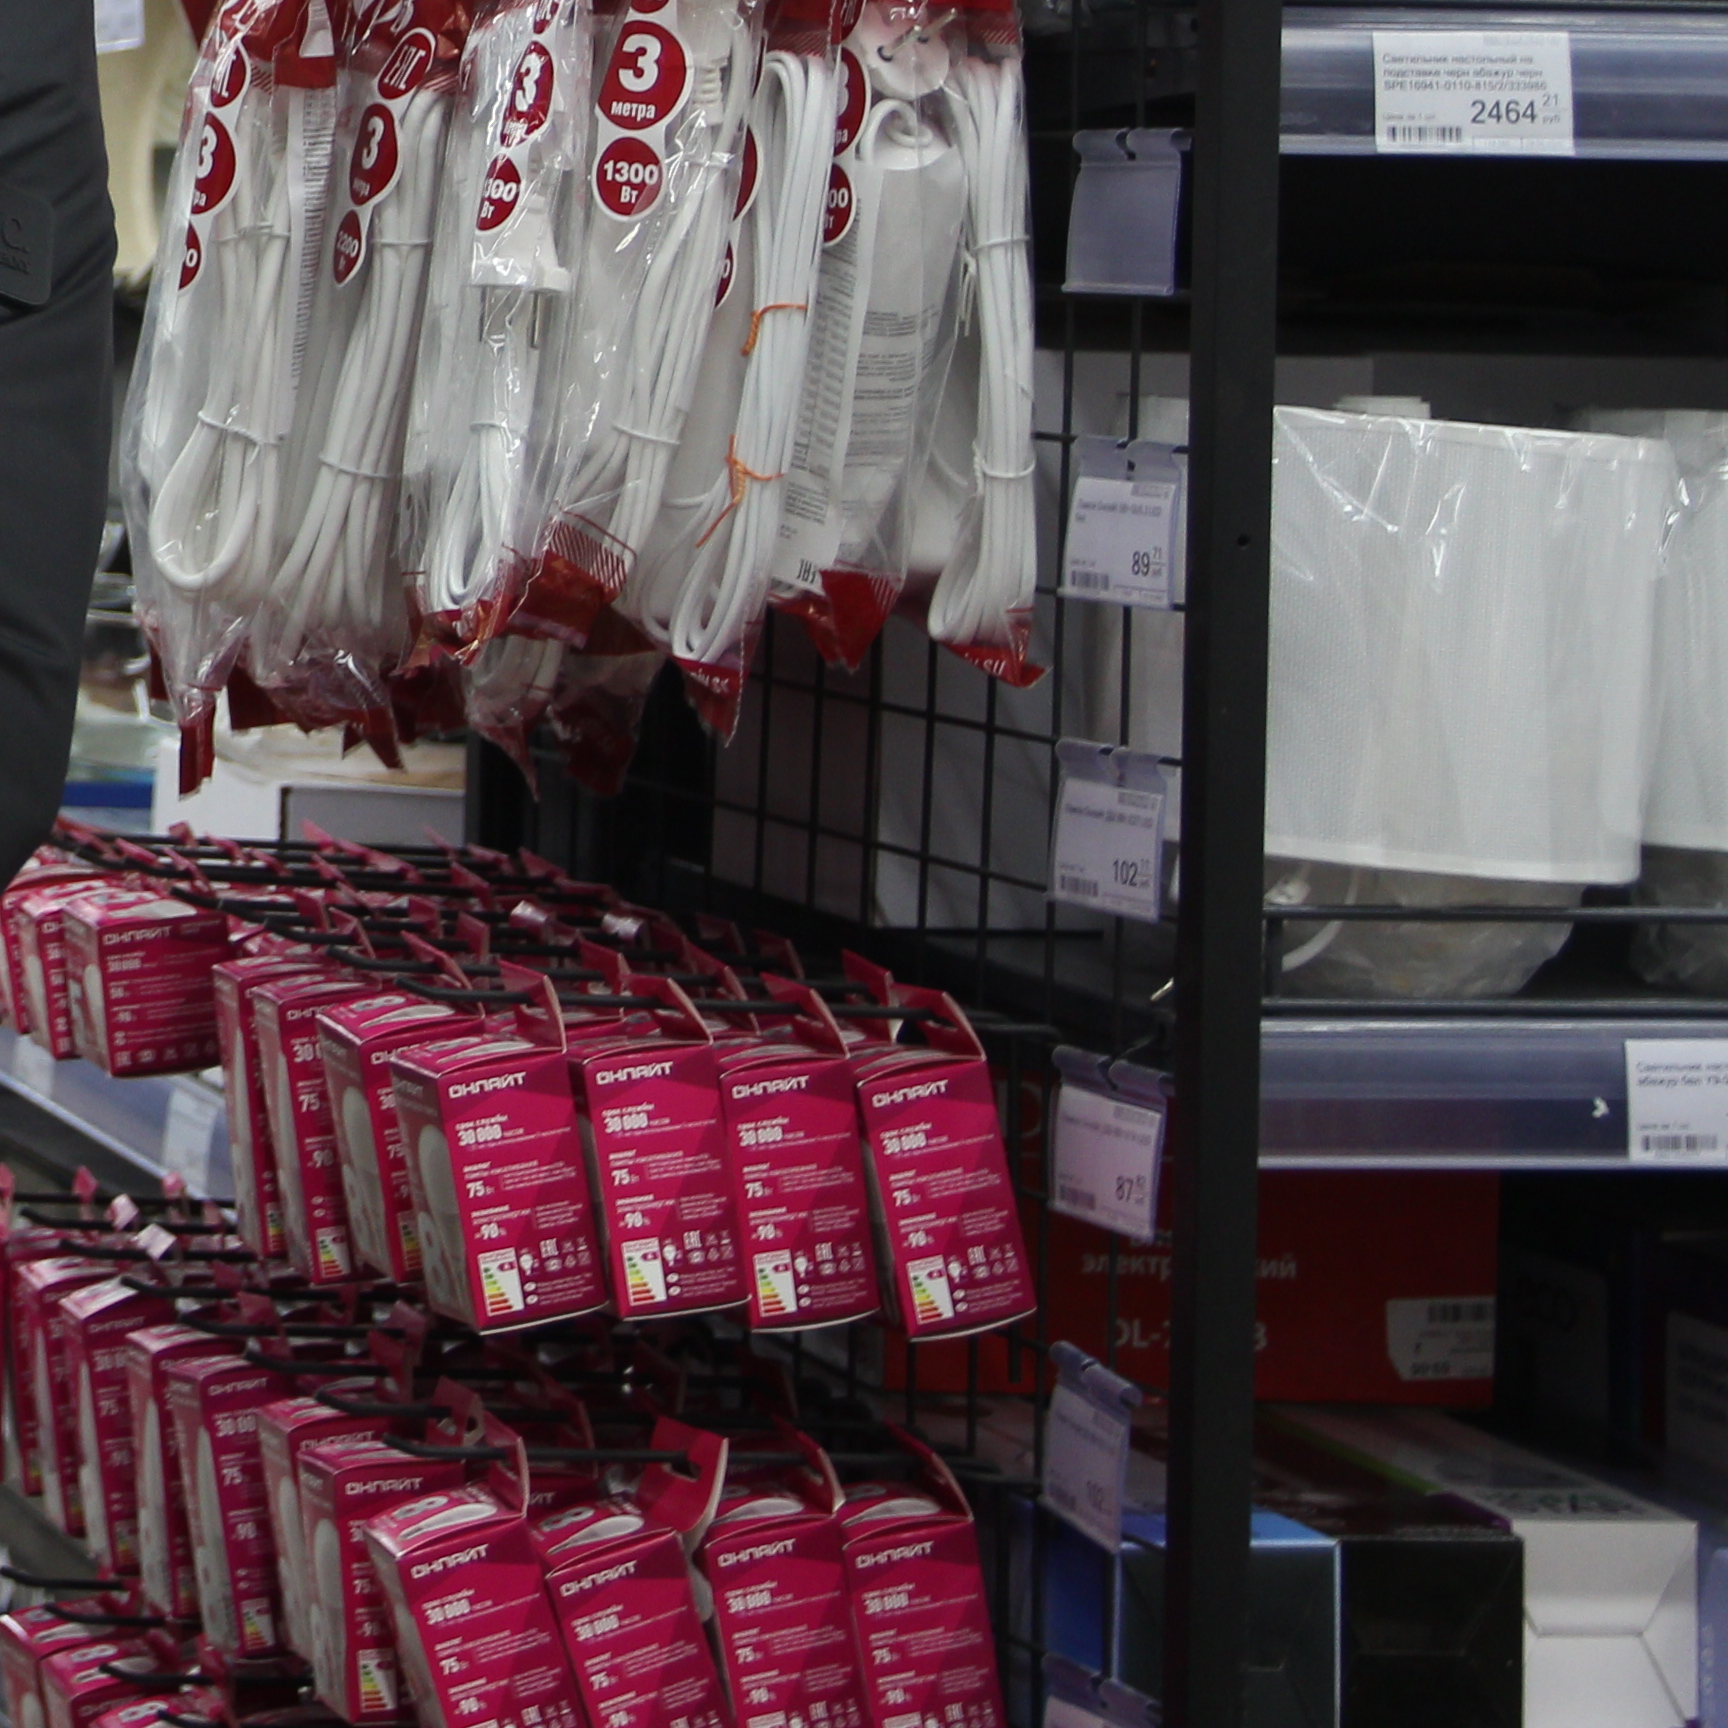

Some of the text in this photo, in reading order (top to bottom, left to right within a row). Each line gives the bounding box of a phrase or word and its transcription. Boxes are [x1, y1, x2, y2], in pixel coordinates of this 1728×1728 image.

[618, 33, 662, 93] 3
[515, 53, 544, 113] 3
[610, 100, 656, 121] метра
[1470, 92, 1560, 125] 2464 21
[361, 115, 385, 171] 3
[603, 160, 660, 186] 1300
[620, 185, 639, 205] Вт
[479, 201, 495, 220] Вт
[1131, 549, 1150, 577] 89
[1112, 857, 1139, 887] 102
[448, 1071, 527, 1100] ОНЛАЙТ
[595, 1060, 674, 1085] ОНЛАЙТ
[732, 1074, 810, 1100] ОНЛАЙТ
[871, 1079, 949, 1109] ОНЛАЙТ
[410, 1543, 489, 1579] ОНЛАЙТ
[717, 1538, 796, 1568] ОНЛАЙТ
[855, 1540, 934, 1569] ОНЛАЙТ
[559, 1560, 638, 1597] ОНЛАЙТ
